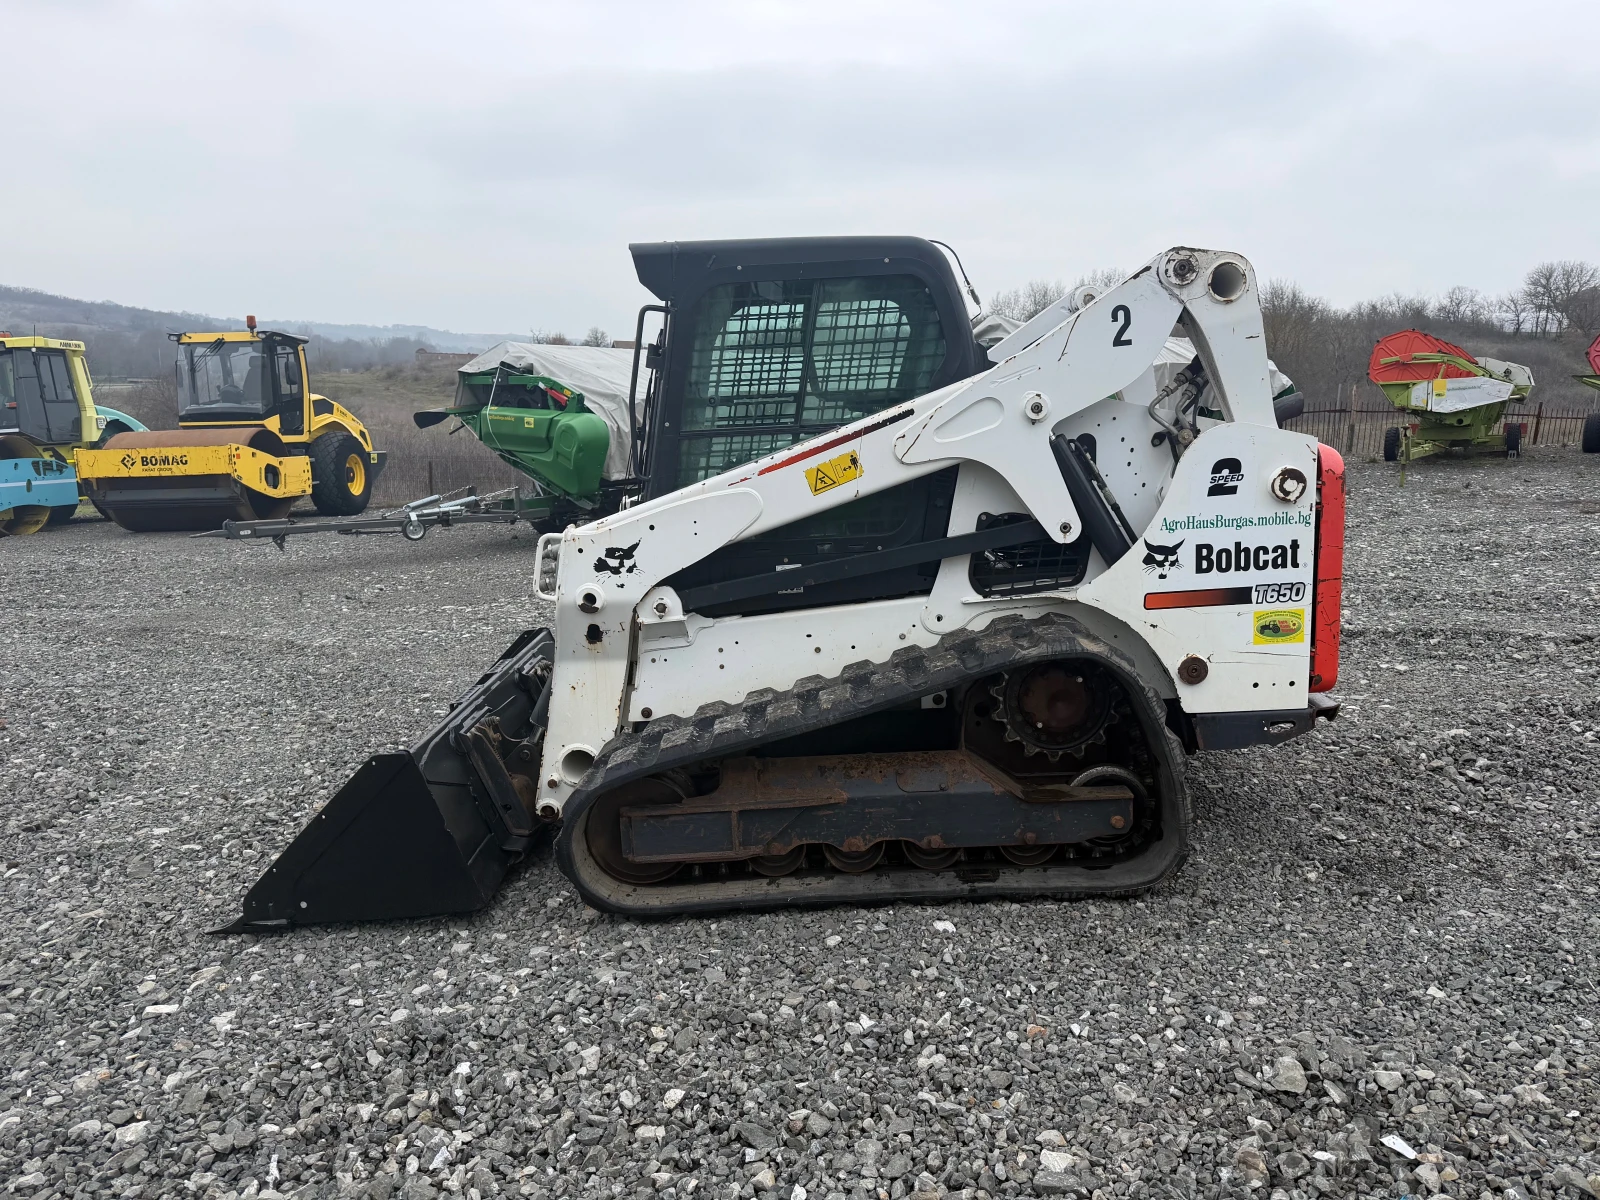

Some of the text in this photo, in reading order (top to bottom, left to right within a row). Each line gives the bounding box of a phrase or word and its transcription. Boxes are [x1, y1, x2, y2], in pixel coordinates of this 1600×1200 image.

[1111, 304, 1132, 347] 2
[140, 454, 188, 466] BOMAG
[1207, 457, 1242, 497] 2
[1209, 473, 1244, 484] SPEED
[1160, 510, 1311, 534] AgroHausBurgas.mobile.bg
[1195, 539, 1300, 574] Bobcat
[1254, 582, 1305, 605] T650
